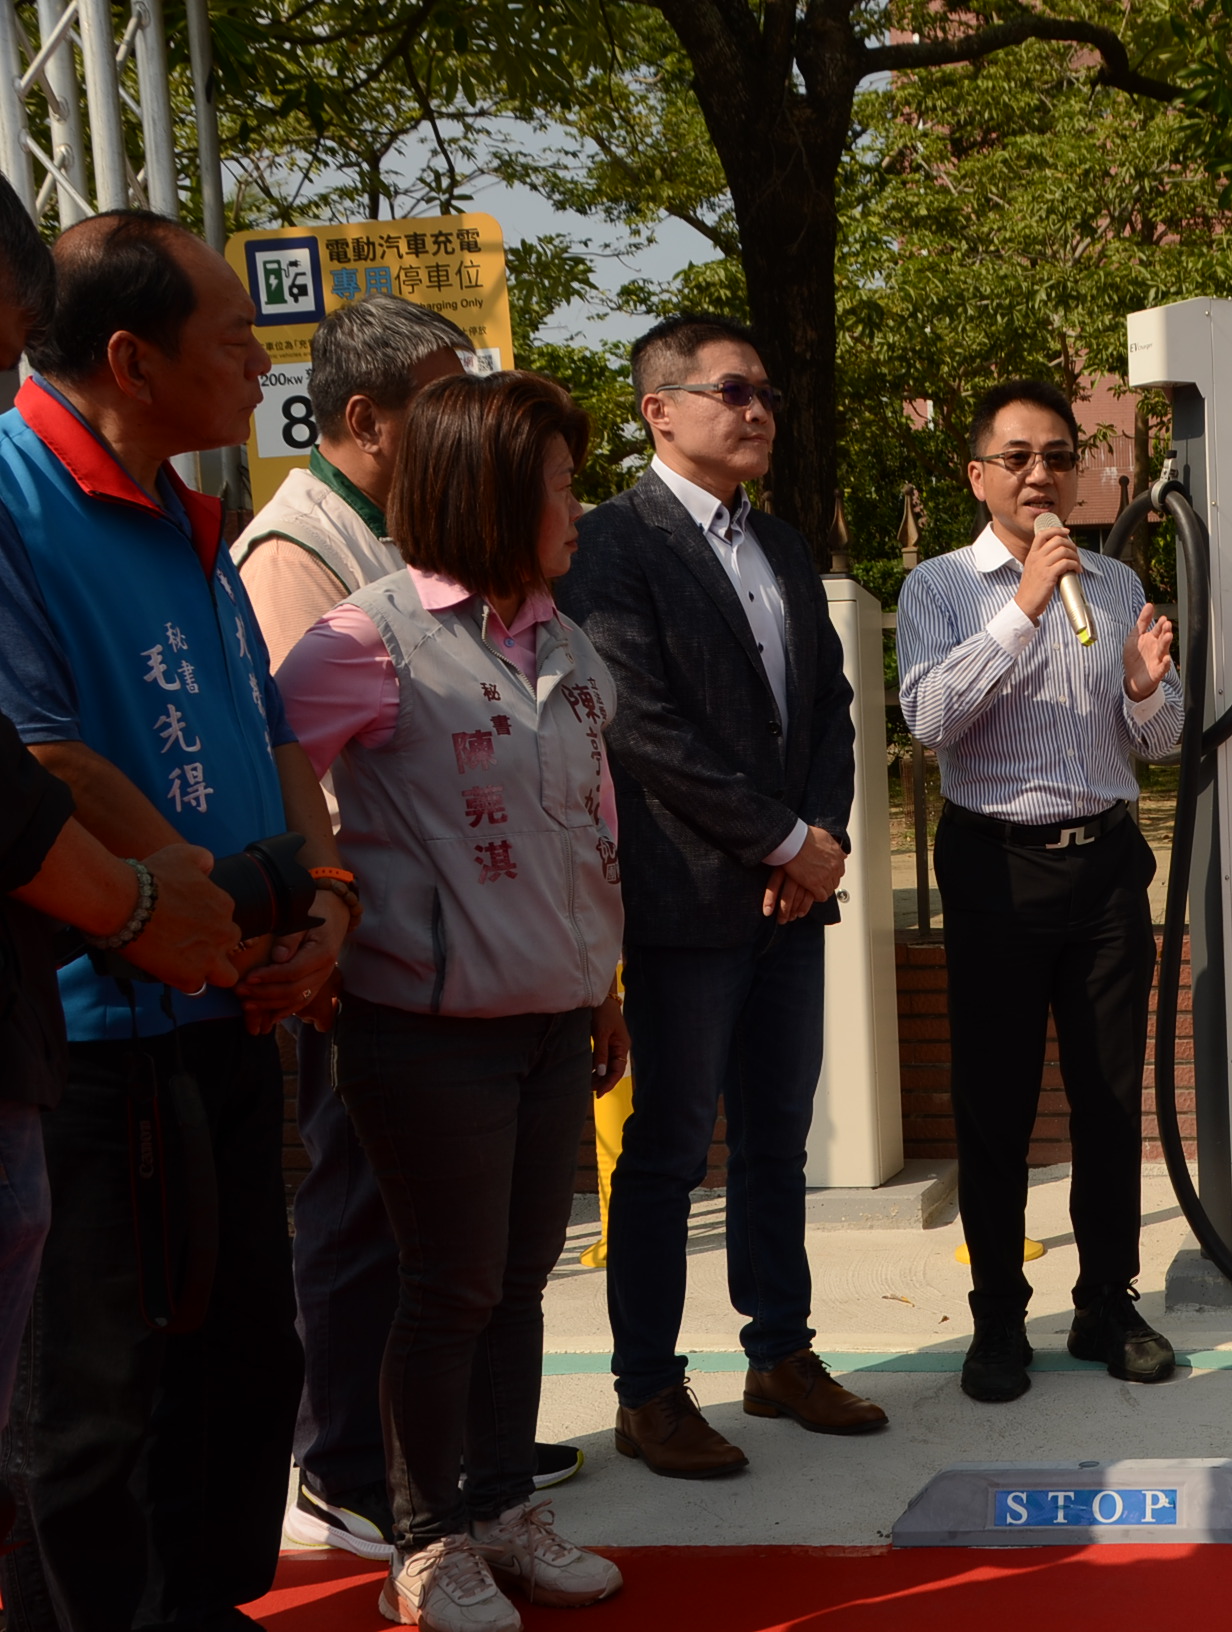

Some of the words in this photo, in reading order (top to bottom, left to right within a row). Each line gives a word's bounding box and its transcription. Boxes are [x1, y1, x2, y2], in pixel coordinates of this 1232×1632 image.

[325, 228, 482, 264] 電動汽車充電
[330, 259, 484, 300] 專用停車位
[419, 301, 458, 311] harging
[461, 298, 483, 309] Only
[282, 395, 318, 449] 8
[164, 621, 200, 694] 秘書
[140, 644, 214, 813] 毛先得
[480, 682, 512, 736] 秘書
[1006, 1490, 1174, 1525] STOP
